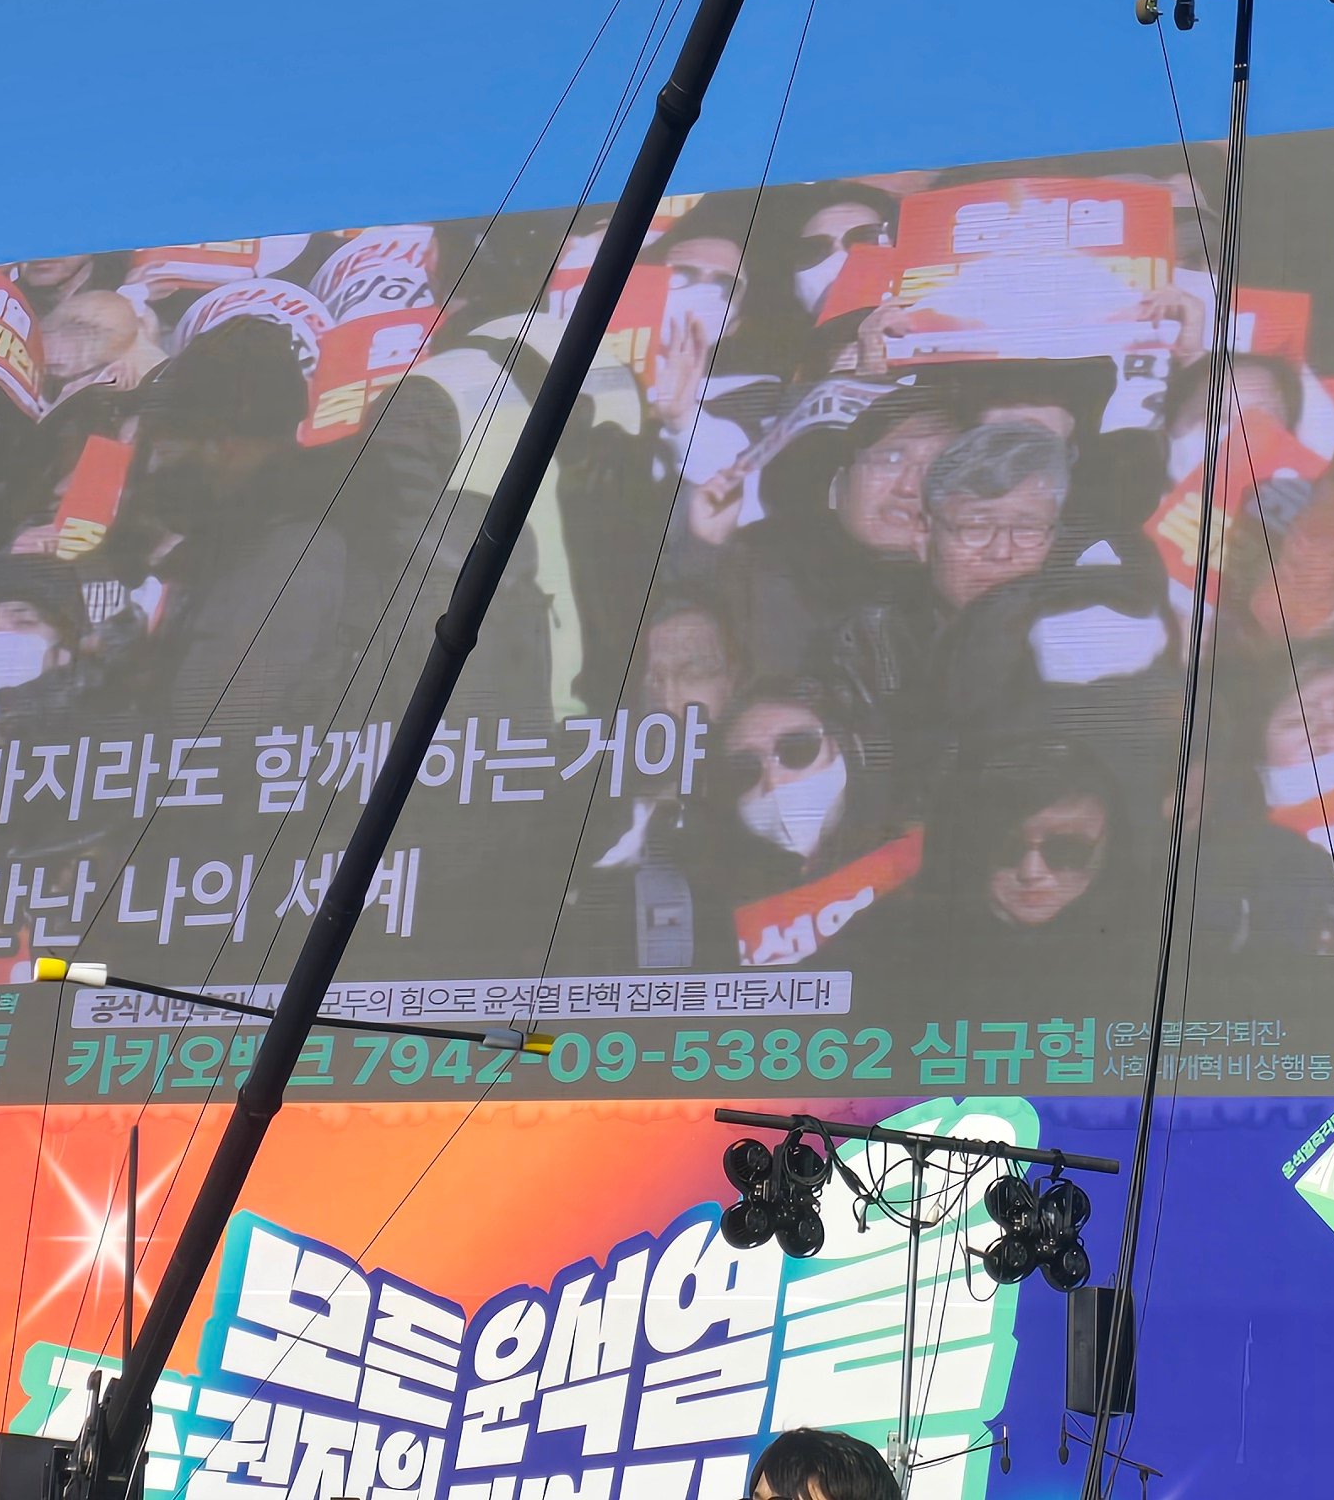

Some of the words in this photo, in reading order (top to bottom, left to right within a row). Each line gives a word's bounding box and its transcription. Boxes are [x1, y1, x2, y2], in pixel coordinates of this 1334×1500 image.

[254, 721, 392, 814] 함께
[415, 705, 708, 804] 하는거야
[118, 854, 254, 945] 나의
[275, 848, 420, 938] 세계
[90, 994, 141, 1024] 공식
[318, 987, 393, 1018] 모두의
[400, 986, 477, 1016] 힘으로
[482, 983, 561, 1015] 윤석열
[568, 981, 621, 1013] 탄핵
[627, 980, 708, 1012] 집회를
[714, 978, 831, 1010] 만듭시다!
[910, 1016, 1096, 1086] 심규협
[220, 1226, 466, 1430] 모든
